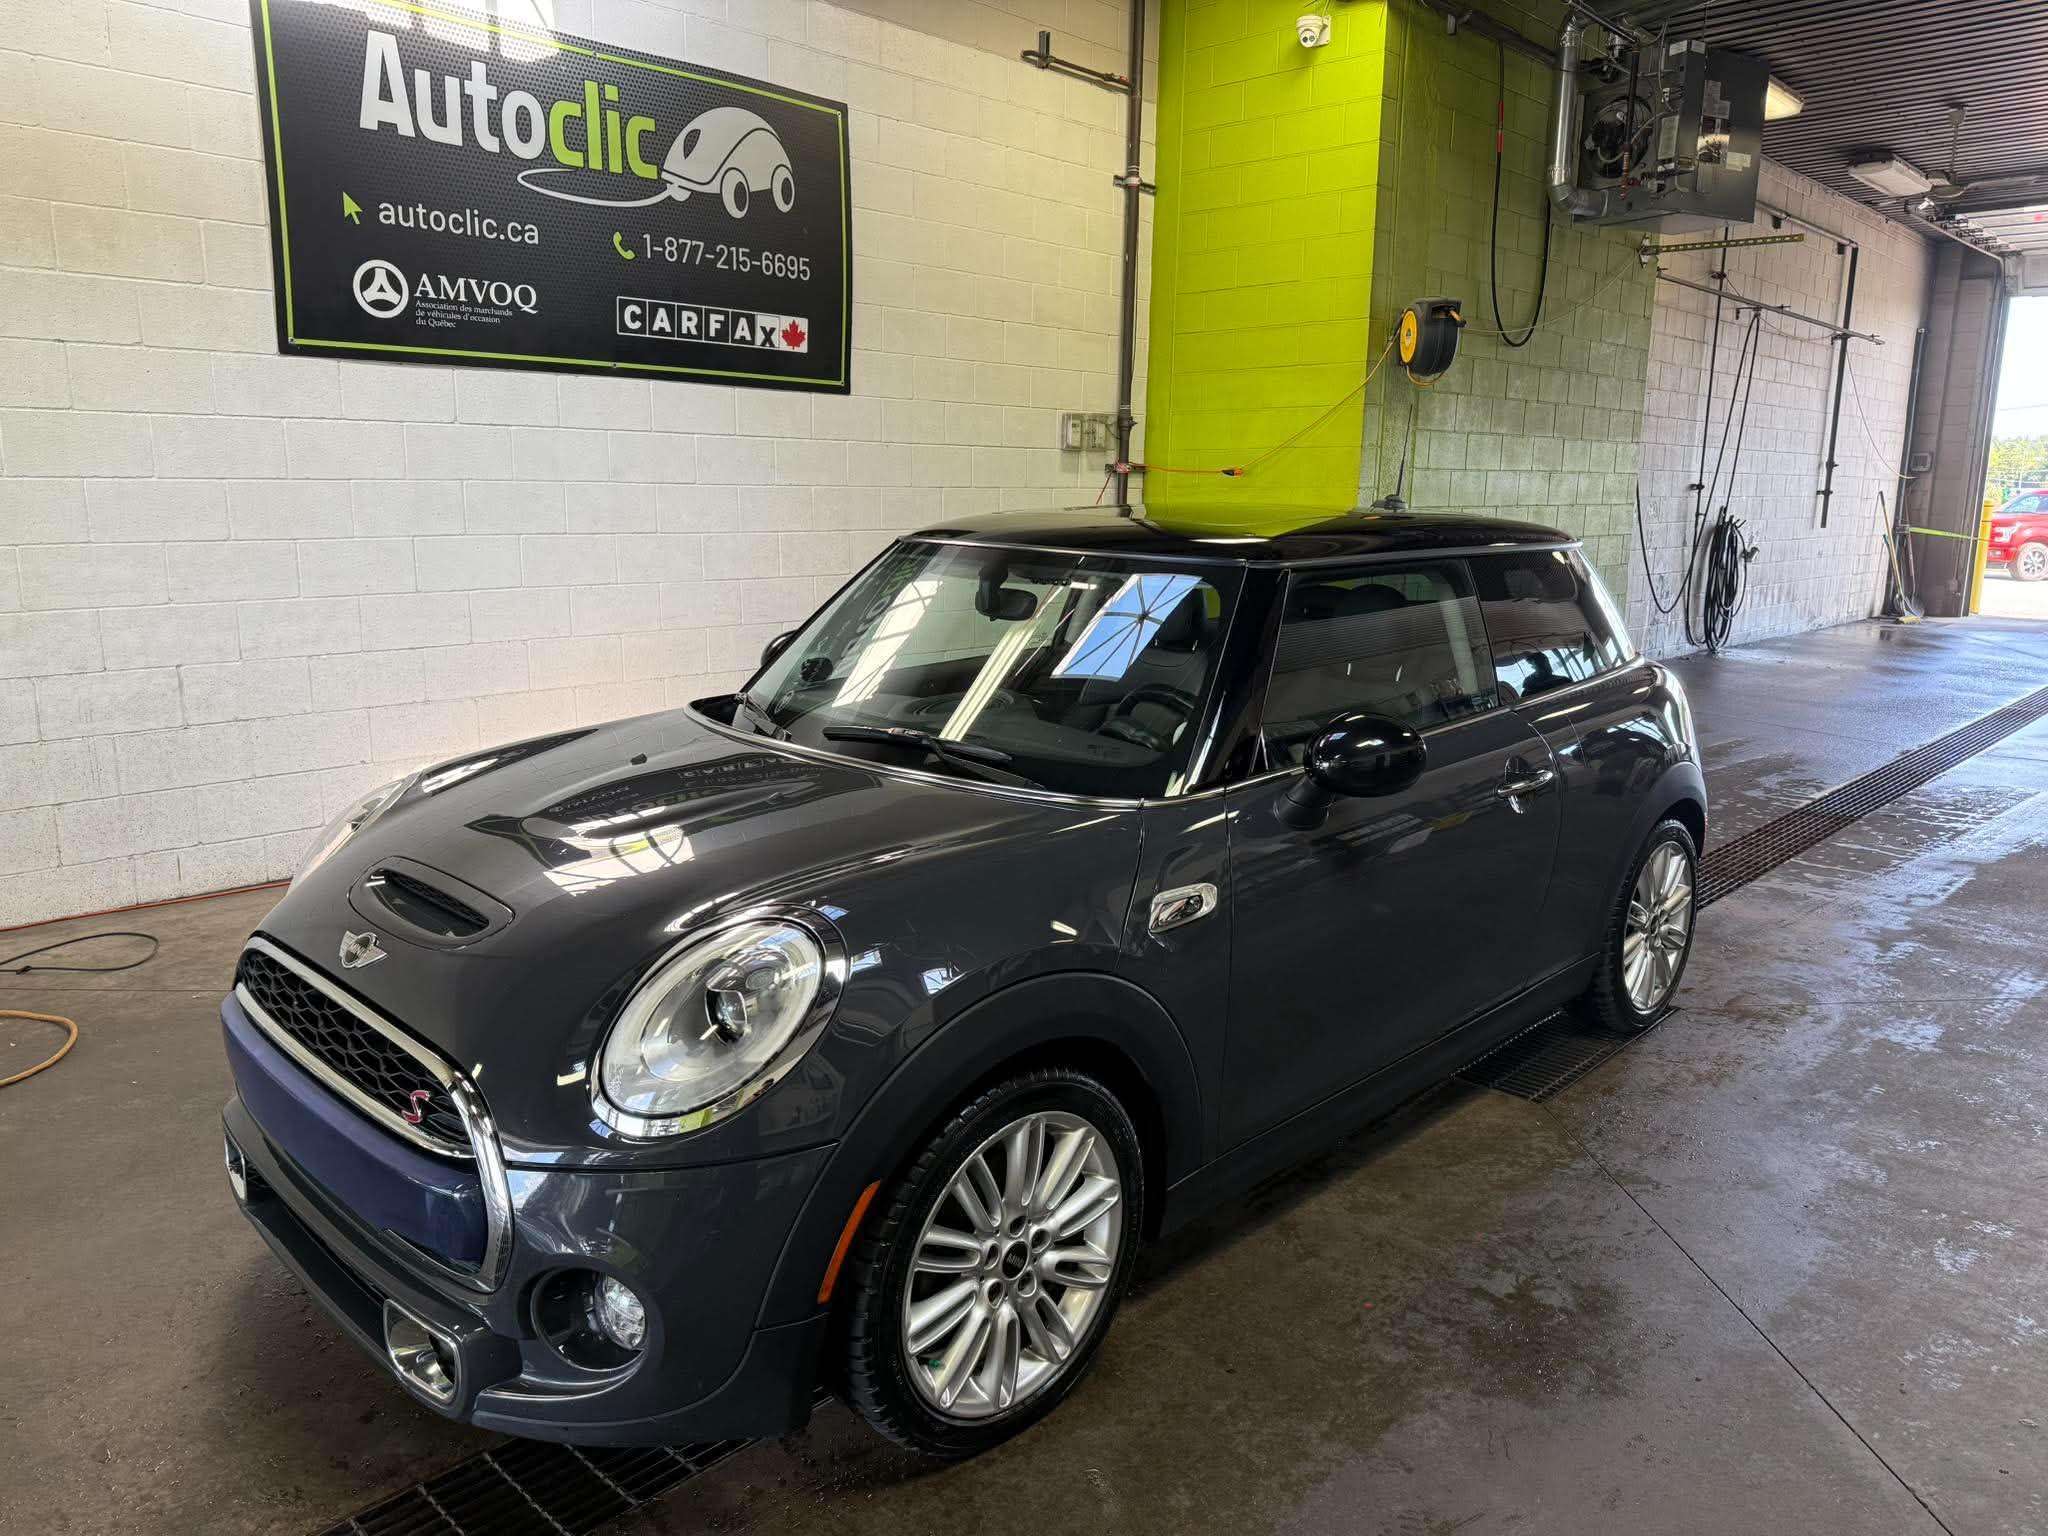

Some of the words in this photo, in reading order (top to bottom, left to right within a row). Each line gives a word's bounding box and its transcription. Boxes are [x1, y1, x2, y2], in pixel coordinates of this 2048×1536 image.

[360, 29, 658, 180] Autoclic
[378, 202, 539, 245] autoclic.ca
[643, 233, 811, 281] 1-877-215-6695
[414, 273, 538, 314] AMVOQ
[415, 300, 458, 312] Association
[460, 304, 472, 312] des
[474, 307, 513, 316] marchands
[415, 309, 425, 317] de
[427, 309, 461, 320] véhicules
[416, 317, 427, 325] du
[623, 304, 776, 348] CARFAX
